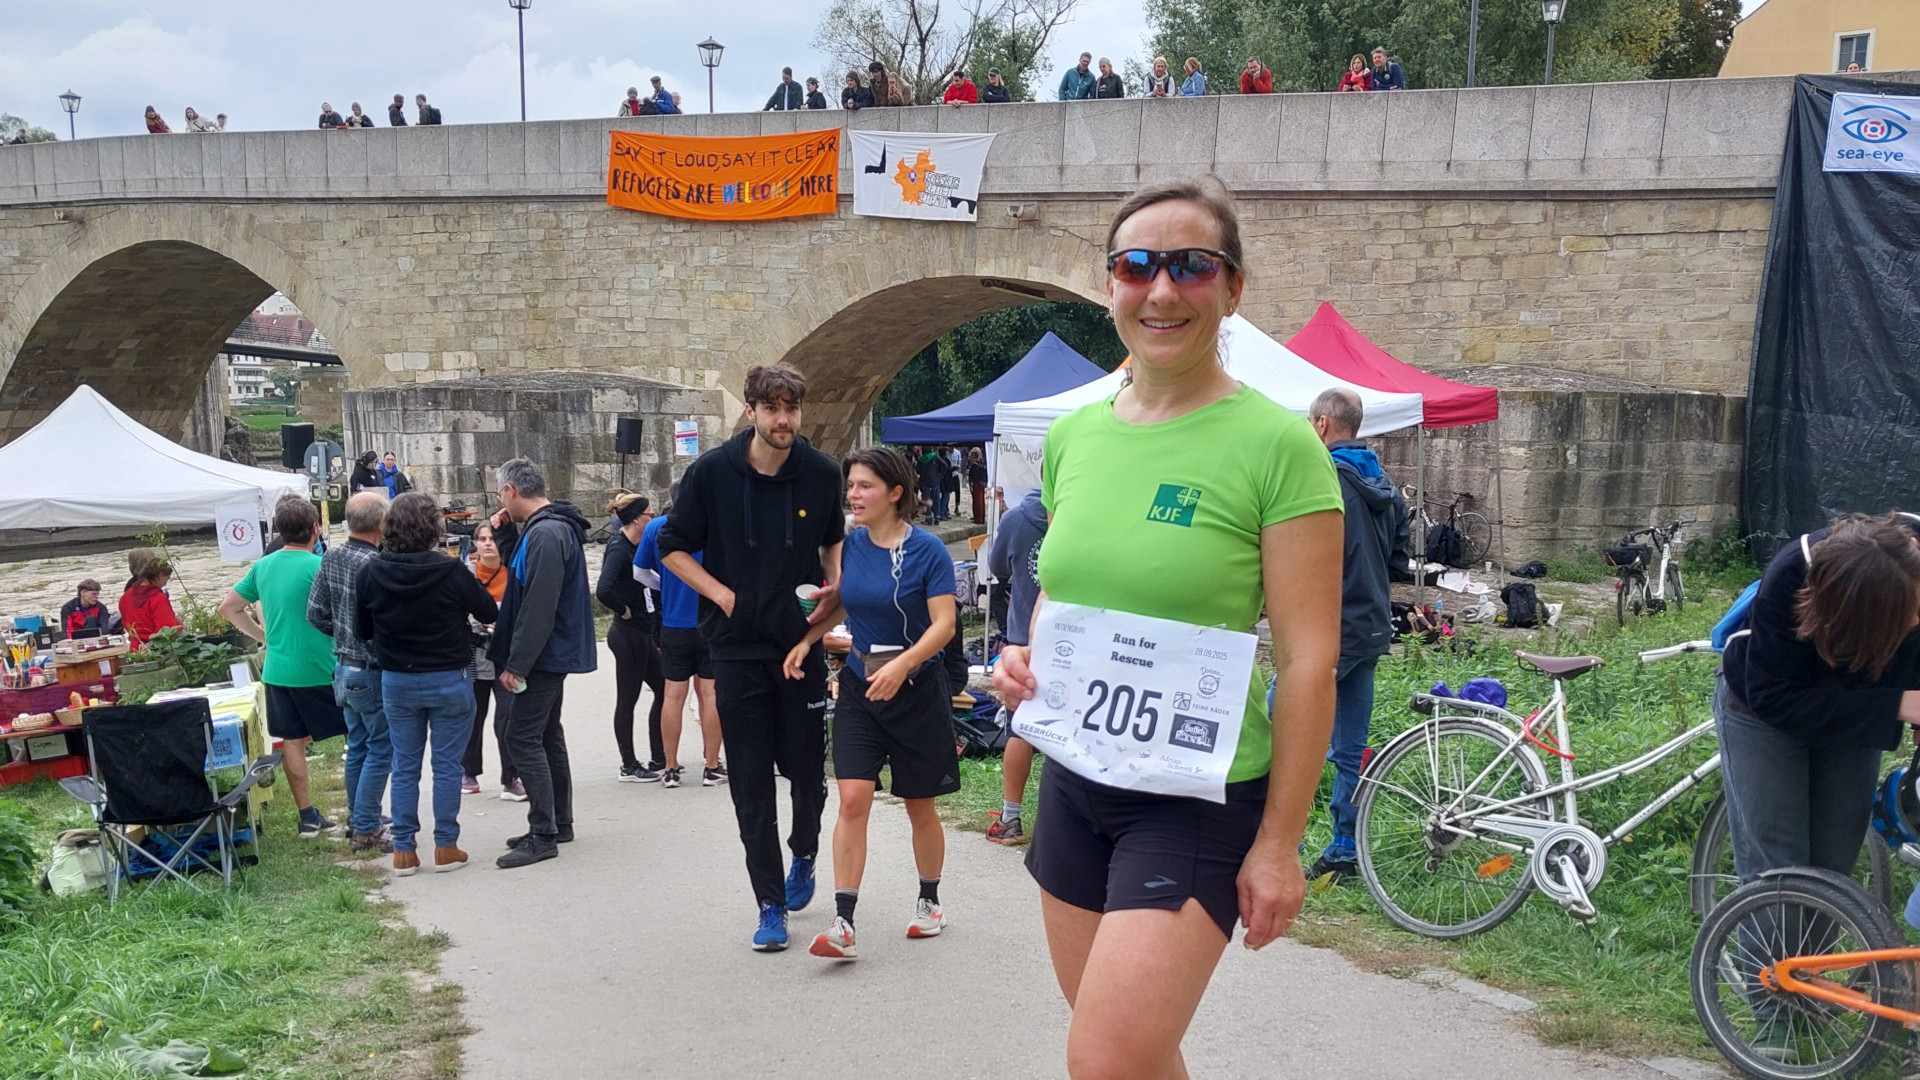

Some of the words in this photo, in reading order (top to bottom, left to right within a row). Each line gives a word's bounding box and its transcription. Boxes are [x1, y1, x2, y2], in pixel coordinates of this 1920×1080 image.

[614, 141, 642, 162] SAY
[651, 151, 666, 167] IT
[723, 151, 756, 168] SAY
[762, 150, 780, 167] IT
[784, 136, 838, 164] CLEAR
[1836, 148, 1904, 162] sea-eye
[612, 168, 681, 200] REFUGEES
[686, 183, 715, 204] ARE
[722, 178, 791, 204] WELCOME
[800, 174, 834, 197] HERE
[1149, 505, 1182, 522] KJF
[1113, 633, 1136, 646] Run
[1139, 637, 1157, 650] for
[1110, 650, 1154, 668] Rescue
[1082, 679, 1163, 742] 205
[1192, 703, 1208, 712] FEINE
[1019, 723, 1069, 743] SEEBRÜCKE
